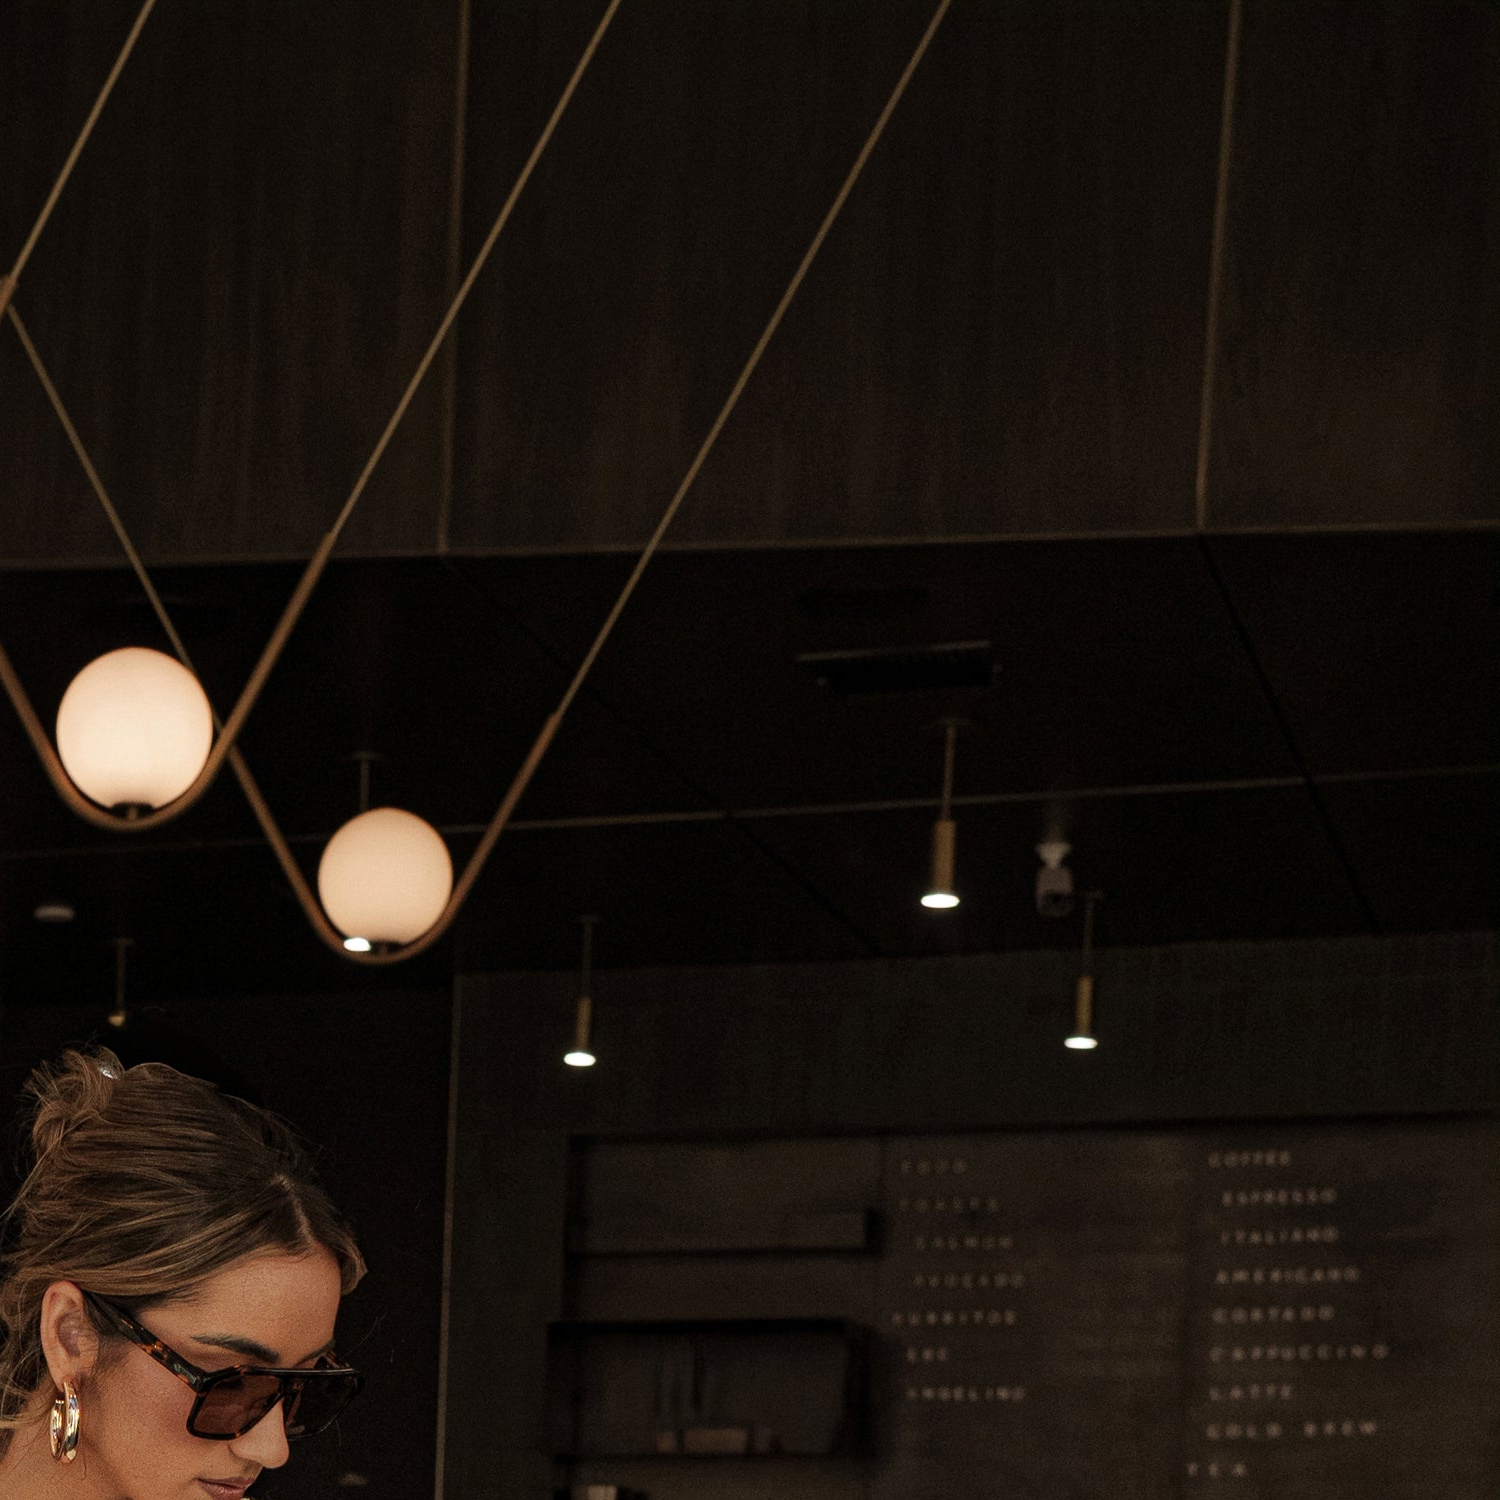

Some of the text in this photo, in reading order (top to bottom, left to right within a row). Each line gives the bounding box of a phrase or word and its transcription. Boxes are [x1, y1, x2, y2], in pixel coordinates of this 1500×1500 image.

[901, 1158, 968, 1174] FOOD
[1208, 1149, 1290, 1168] COFFEE
[1221, 1186, 1338, 1207] ESPRESSO
[915, 1235, 1014, 1250] SALMON
[1219, 1224, 1340, 1246] ITALIANO
[913, 1272, 1027, 1289] AVOCADO
[1214, 1264, 1361, 1285] AMERICANO
[890, 1309, 1018, 1327] BURRITOS
[1211, 1304, 1336, 1325] CORTADO
[1209, 1342, 1390, 1363] CAPPUCCINO
[906, 1385, 1027, 1402] ANGELINO
[1209, 1382, 1293, 1401] LATTE
[1206, 1419, 1378, 1440] COLD BREW
[1186, 1461, 1248, 1478] TEA
